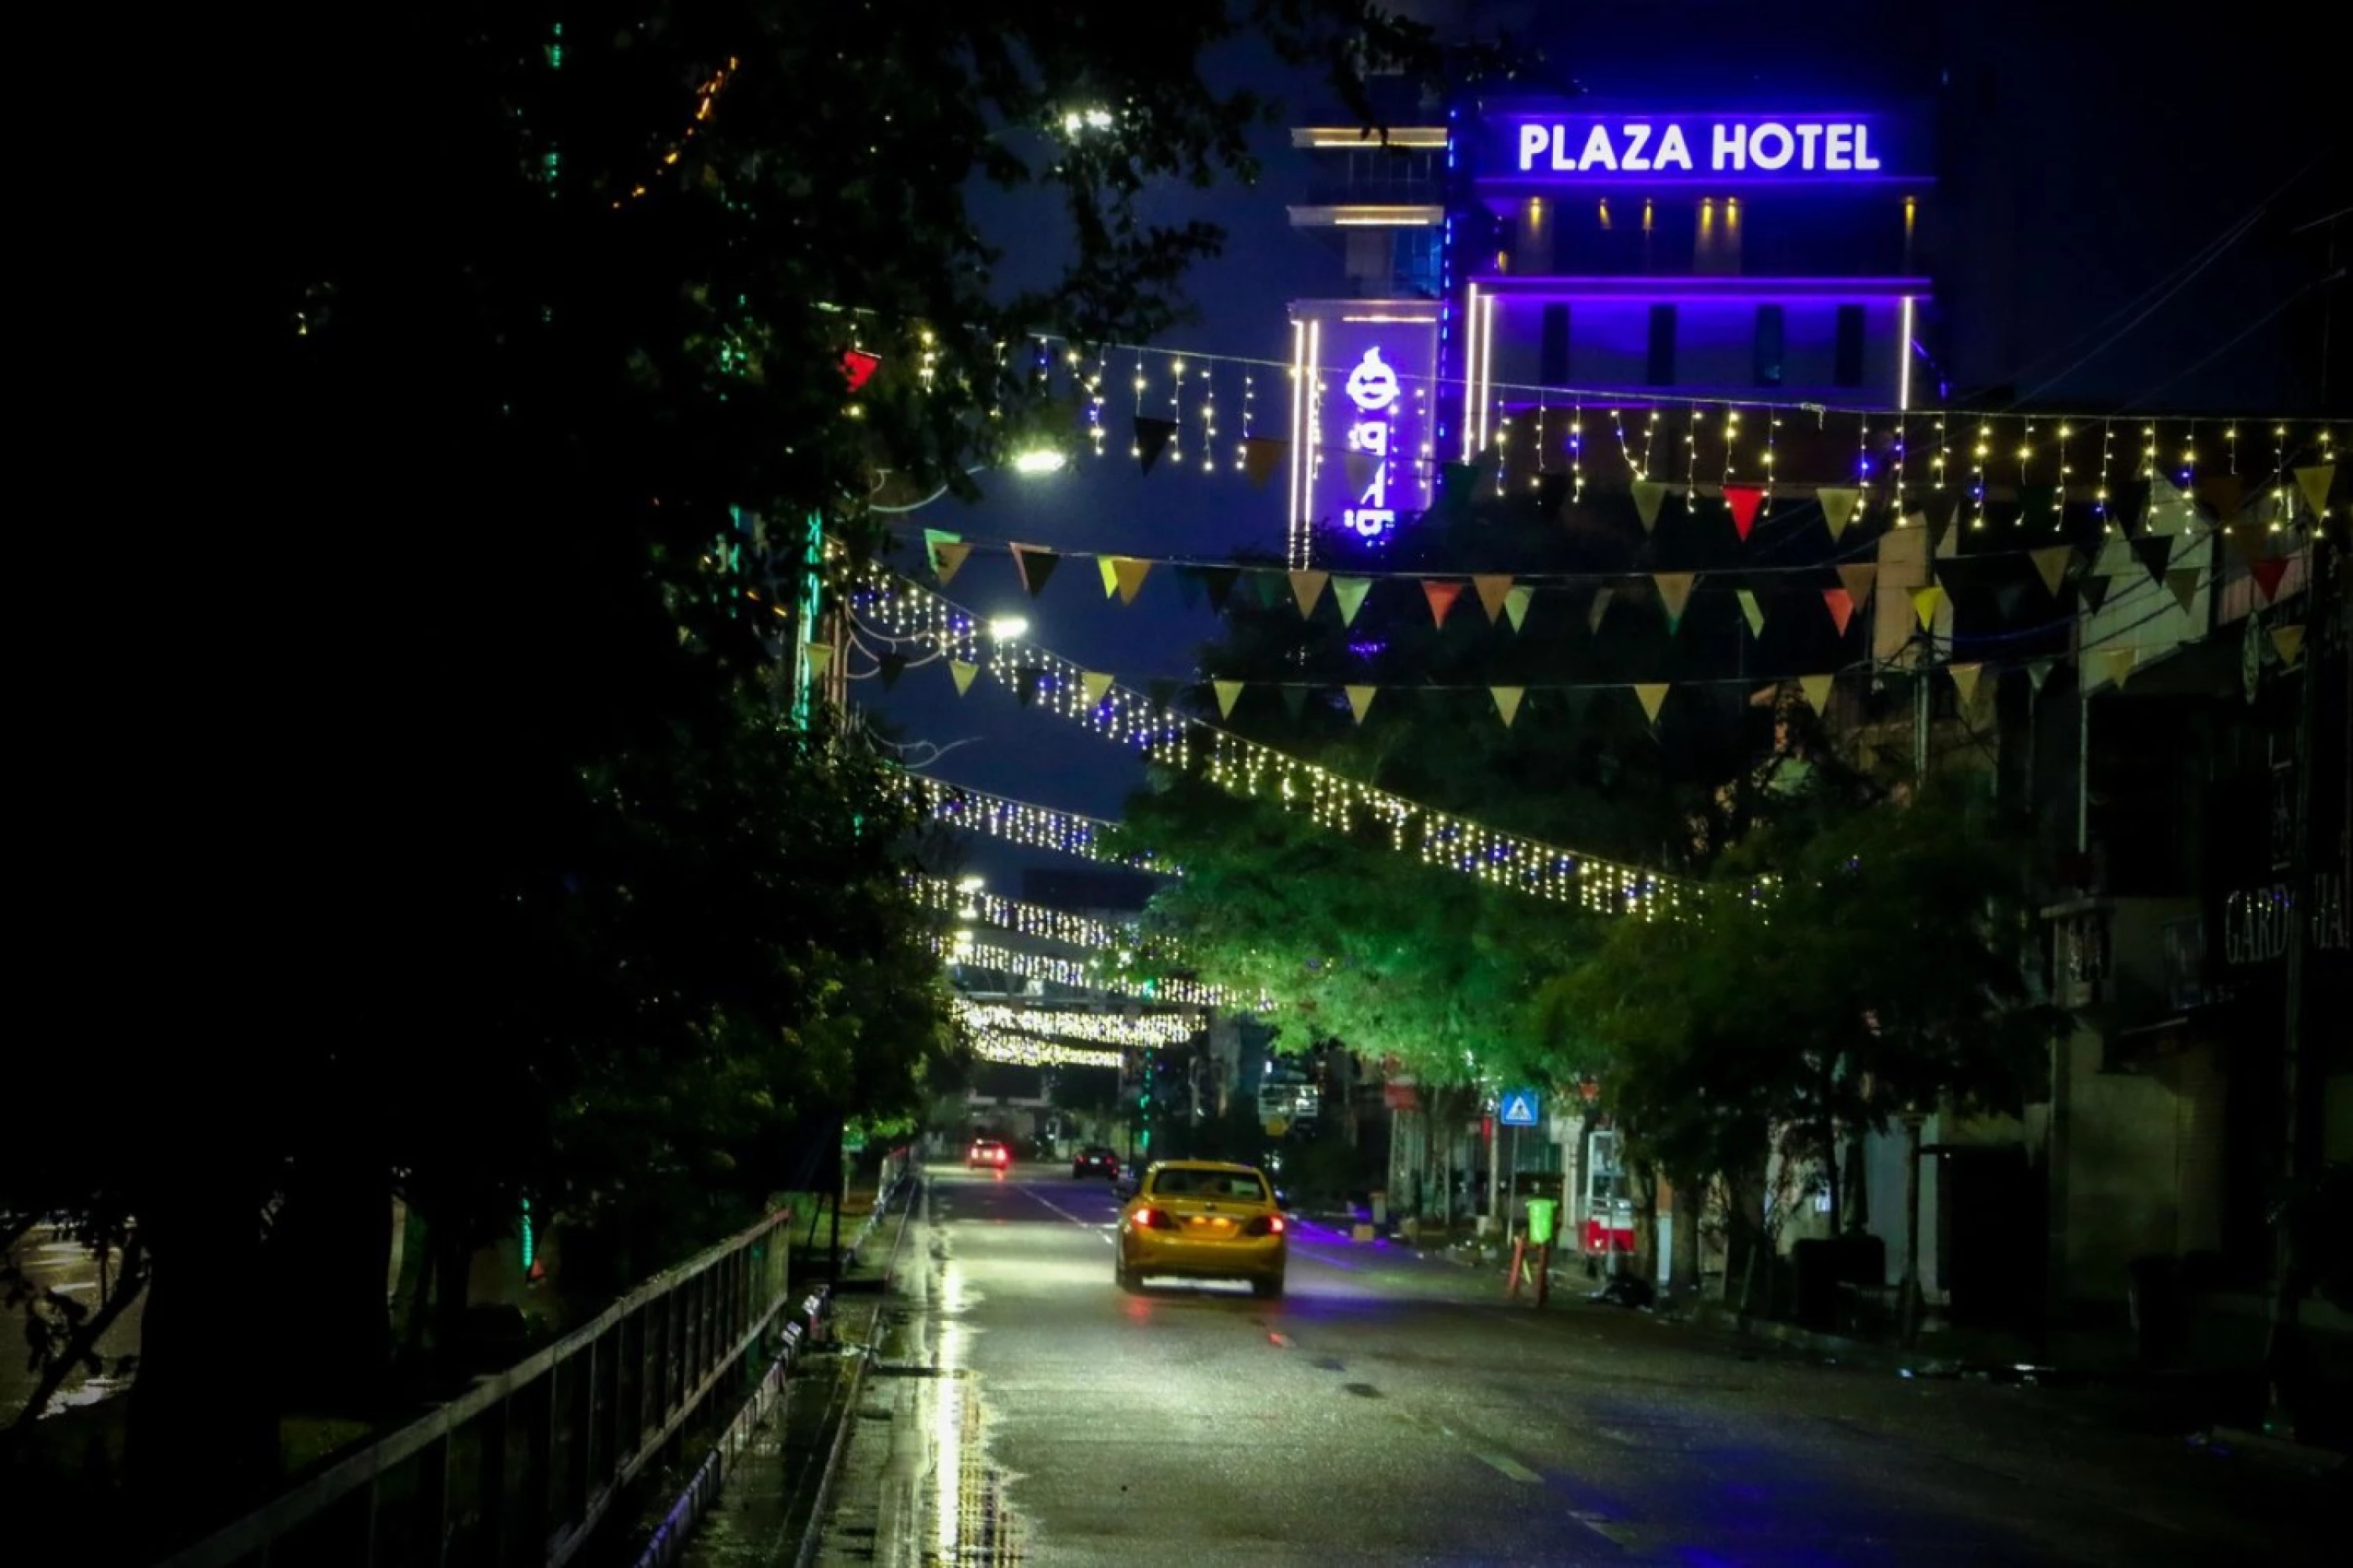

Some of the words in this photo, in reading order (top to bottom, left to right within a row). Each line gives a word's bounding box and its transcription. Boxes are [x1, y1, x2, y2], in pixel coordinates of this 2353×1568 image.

[1519, 123, 1693, 171] PLAZA
[1711, 122, 1881, 171] HOTEL
[1344, 421, 1395, 537] فدق
